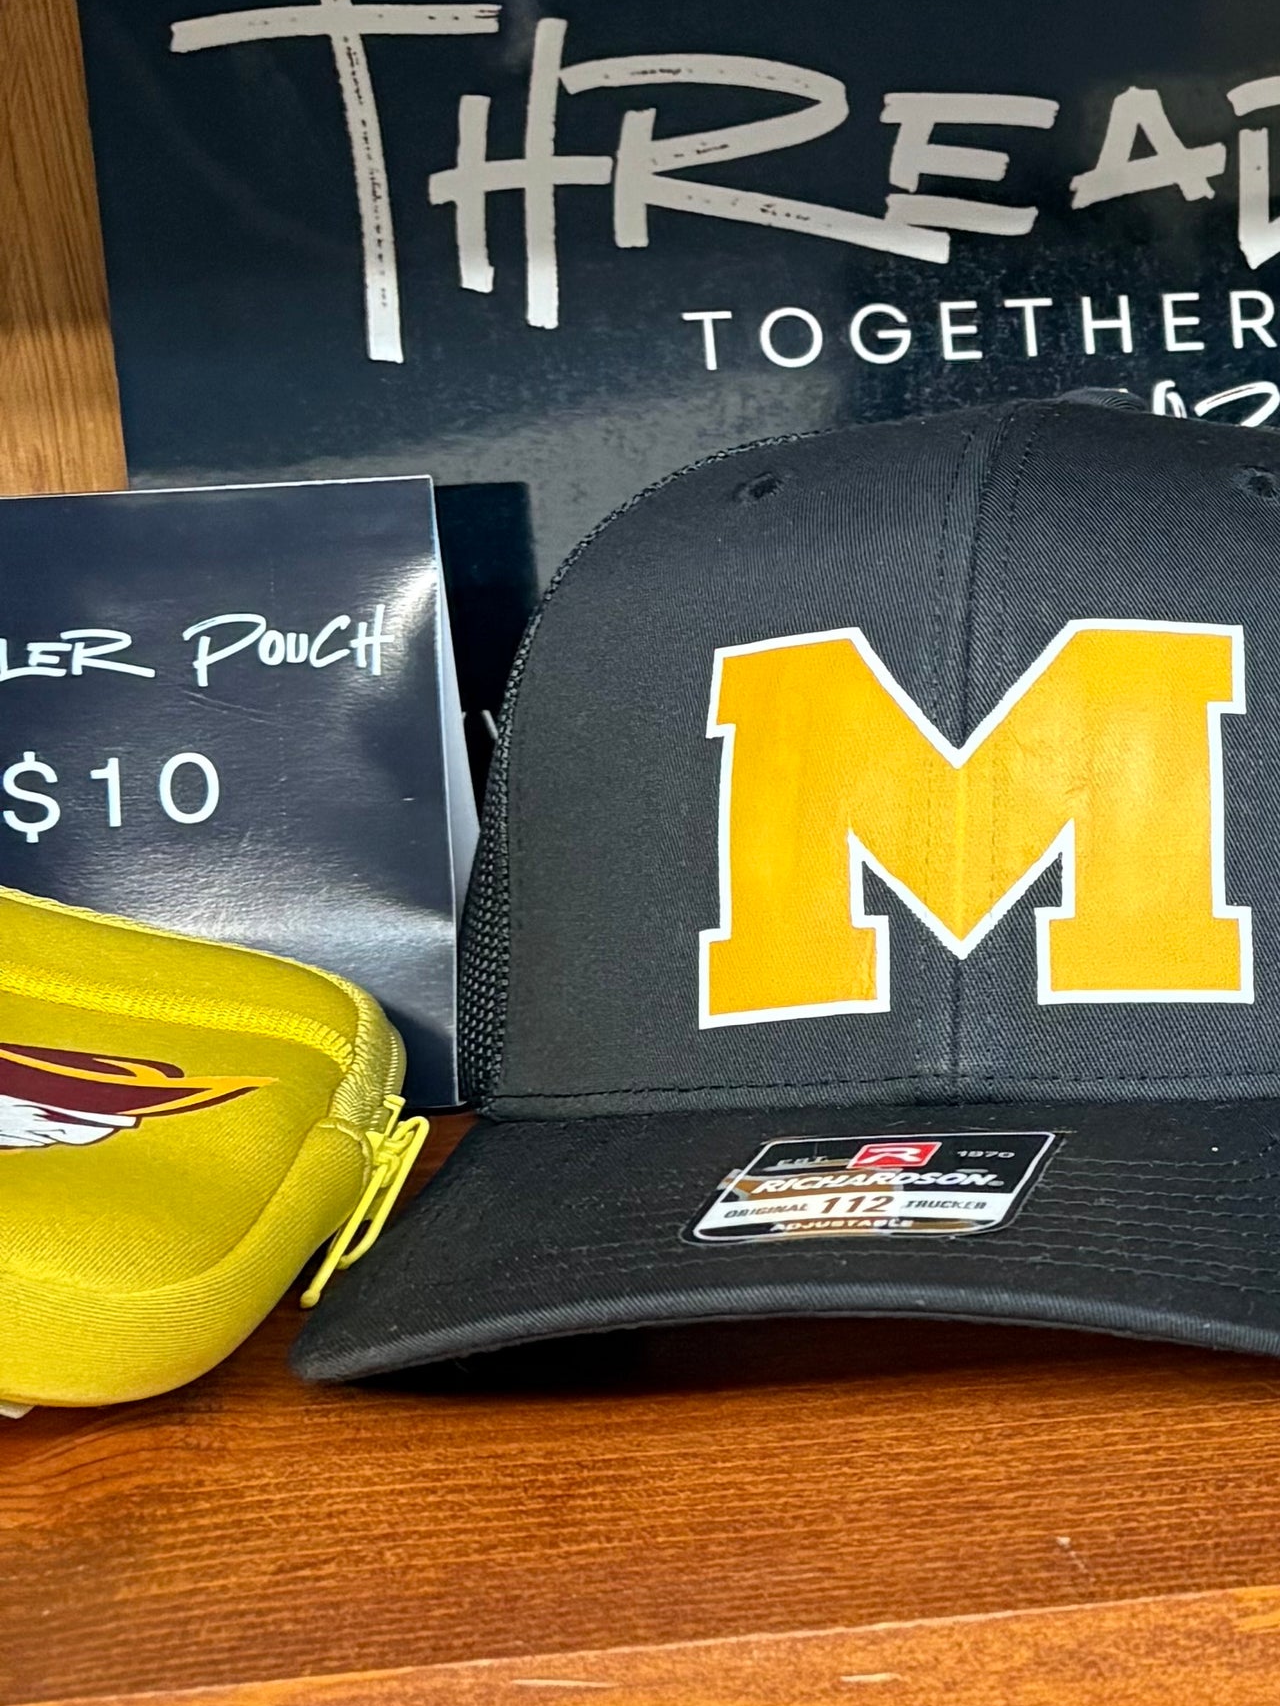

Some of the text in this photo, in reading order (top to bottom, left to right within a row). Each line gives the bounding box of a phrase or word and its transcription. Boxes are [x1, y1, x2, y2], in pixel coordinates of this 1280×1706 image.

[682, 289, 1278, 372] TOGETHER
[2, 750, 220, 844] $10
[699, 618, 1254, 1030] M
[724, 1195, 988, 1219] ORIGINAL 112 TRUCKER
[750, 1172, 999, 1195] RICHARDSON
[769, 1219, 915, 1233] ADJUSTABLE
